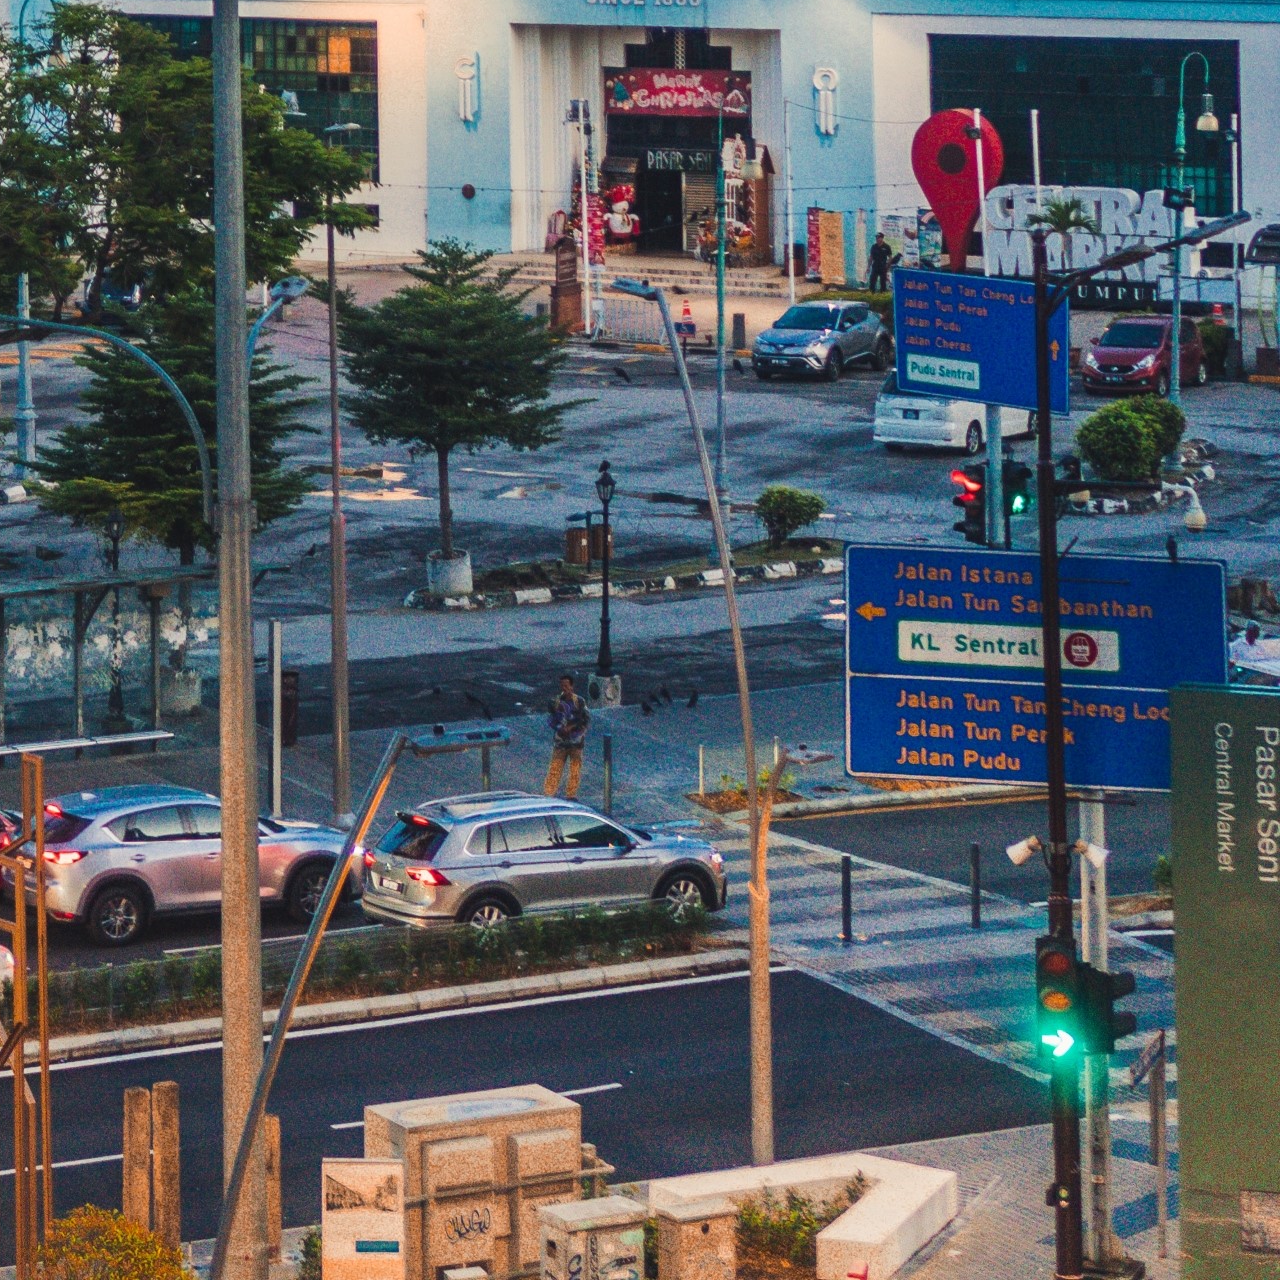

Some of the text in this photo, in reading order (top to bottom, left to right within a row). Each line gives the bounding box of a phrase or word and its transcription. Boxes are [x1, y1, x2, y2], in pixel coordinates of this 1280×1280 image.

[903, 280, 1035, 305] Jalan Tun Tan Cheng Lo
[904, 298, 989, 317] Jalan Tun Perak
[904, 316, 962, 333] Jalan Pudu
[905, 335, 972, 352] Jalan Cheras
[910, 361, 975, 382] Pudu Sentral
[894, 561, 1034, 585] Jalan Istana
[894, 589, 953, 609] Jalan
[961, 592, 1000, 612] Tun
[911, 632, 1041, 657] KL Sentral
[896, 689, 1170, 723] Jalan Tun Tan Cheng Loc
[896, 718, 1075, 745] Jalan Tun Perk
[896, 746, 1021, 771] Jalan Pudu
[1255, 725, 1280, 811] Pasar
[1213, 721, 1236, 873] Central Market
